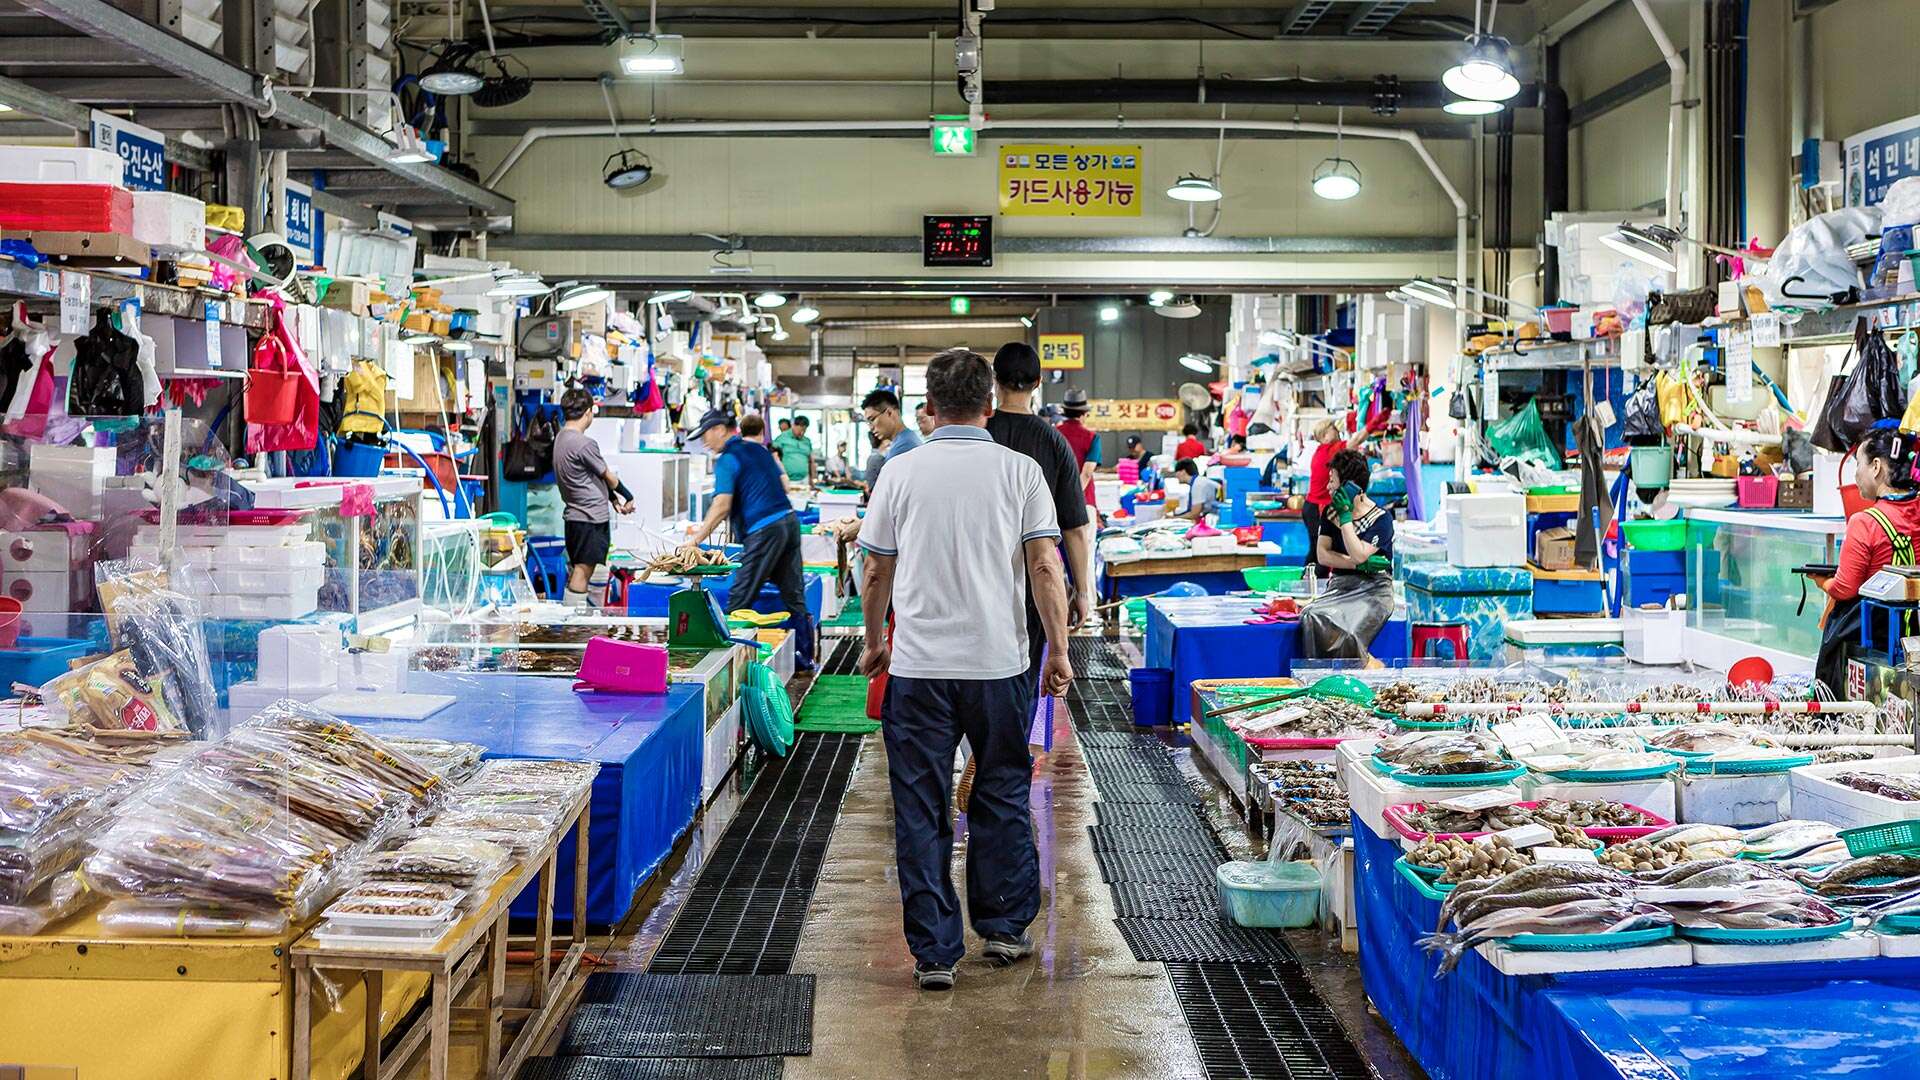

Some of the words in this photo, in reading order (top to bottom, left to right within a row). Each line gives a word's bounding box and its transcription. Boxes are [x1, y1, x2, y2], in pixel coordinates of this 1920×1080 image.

[120, 141, 164, 184] 유진수산
[1035, 154, 1068, 170] 모든
[1073, 154, 1107, 171] 상가
[1867, 136, 1919, 181] 석민네
[1009, 179, 1135, 205] 카드사용가능
[286, 195, 309, 229] 희네
[1118, 403, 1149, 418] 젓갈
